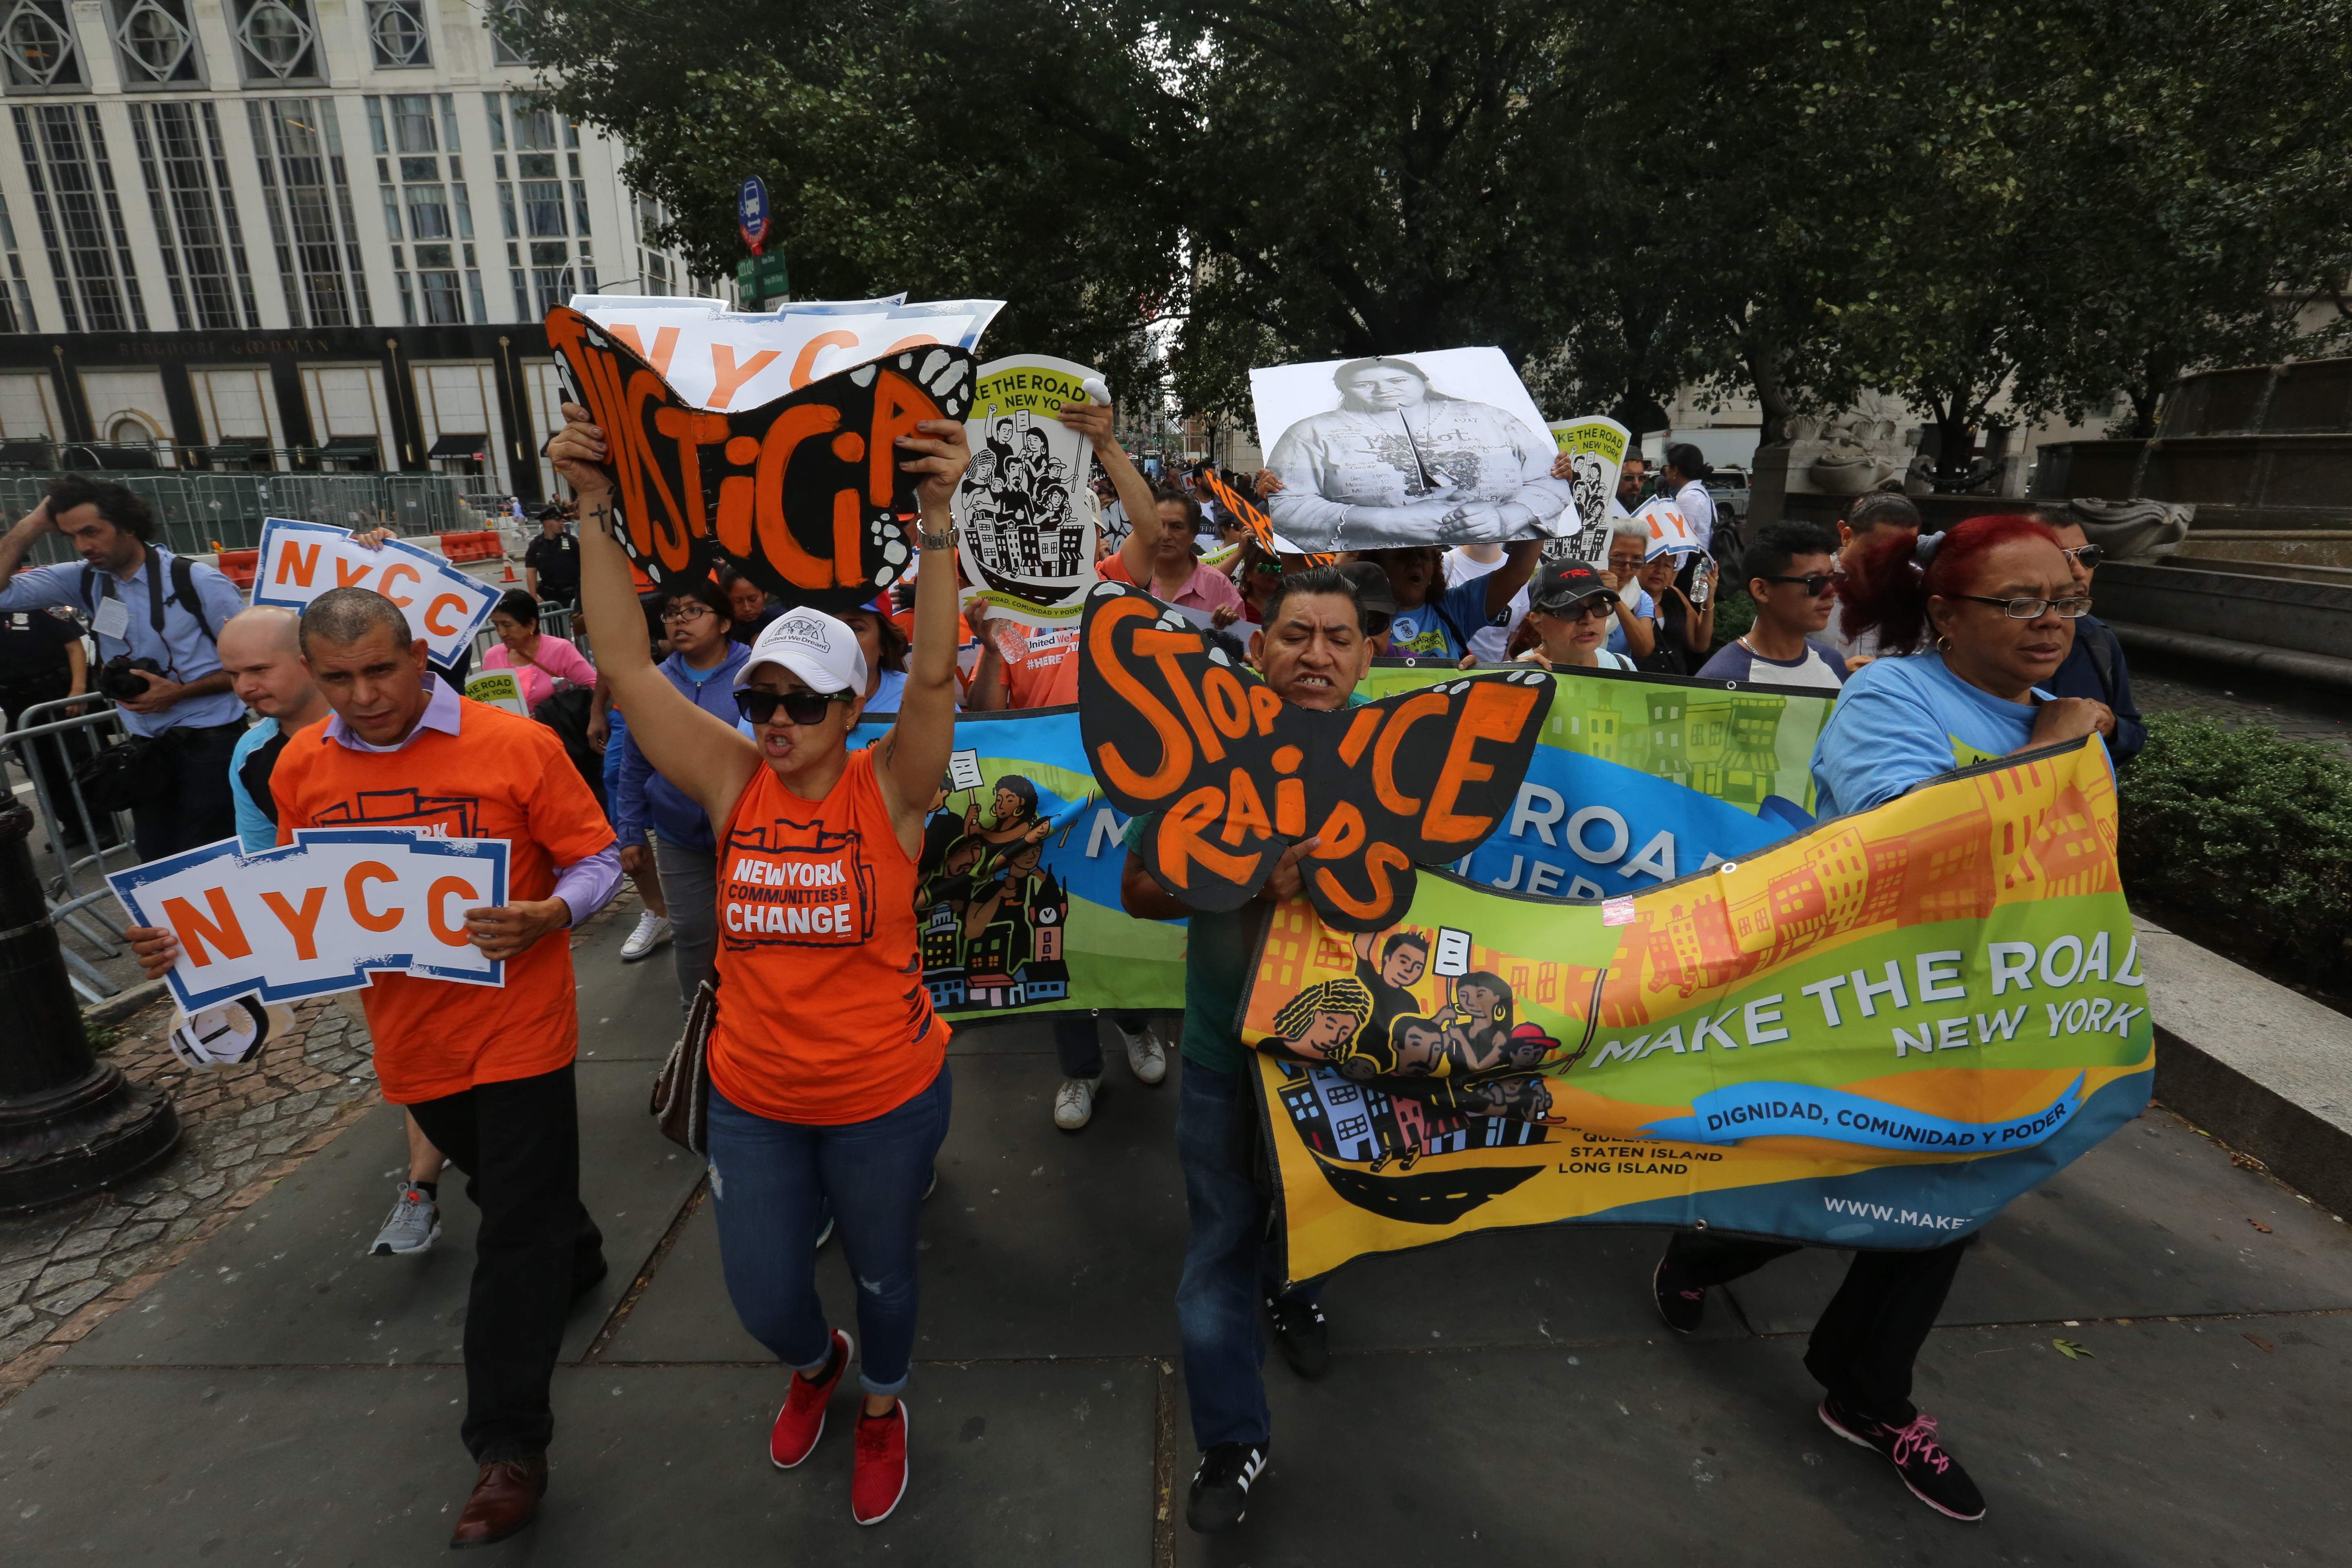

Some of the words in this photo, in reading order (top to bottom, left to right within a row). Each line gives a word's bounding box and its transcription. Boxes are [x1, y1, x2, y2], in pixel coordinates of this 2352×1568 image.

[740, 283, 753, 298] MTA
[118, 341, 217, 356] BERGDORF
[231, 340, 329, 354] GOODMAN
[992, 374, 1027, 394] THE
[1031, 374, 1086, 402] ROAD
[1005, 394, 1038, 408] NEW
[1577, 428, 1598, 440] THE
[1599, 429, 1623, 449] ROAD
[1583, 441, 1601, 449] NEW
[1604, 443, 1620, 460] YORK
[1206, 556, 1225, 566] MAKE
[1559, 568, 1592, 579] TRD
[1012, 601, 1052, 615] COMUNIDAD
[1060, 606, 1083, 615] PODER
[764, 635, 786, 645] United
[1056, 634, 1069, 644] We
[481, 679, 512, 690] ROAD
[1089, 595, 1283, 802] STOP
[1338, 682, 1540, 844] ICE
[728, 883, 839, 904] COMMUNITIES
[160, 860, 480, 968] NYCC
[726, 902, 852, 934] CHANGE
[1588, 993, 1790, 1069] MAKE
[1801, 950, 1966, 1028] THE
[1988, 931, 2145, 996] ROAD
[1891, 1004, 2029, 1058] NEW
[2045, 998, 2145, 1038] YORK
[1706, 1100, 1829, 1133] DIGNIDAD,
[1836, 1109, 1976, 1147] COMUNIDAD
[1982, 1130, 1997, 1145] Y
[2001, 1101, 2067, 1143] PODER
[1570, 1147, 1644, 1158] STATEN
[1650, 1148, 1724, 1162] ISLAND
[1558, 1162, 1611, 1174] LONG
[1617, 1163, 1688, 1175] ISLAND
[1824, 1196, 1973, 1230] WWW.MAKE
